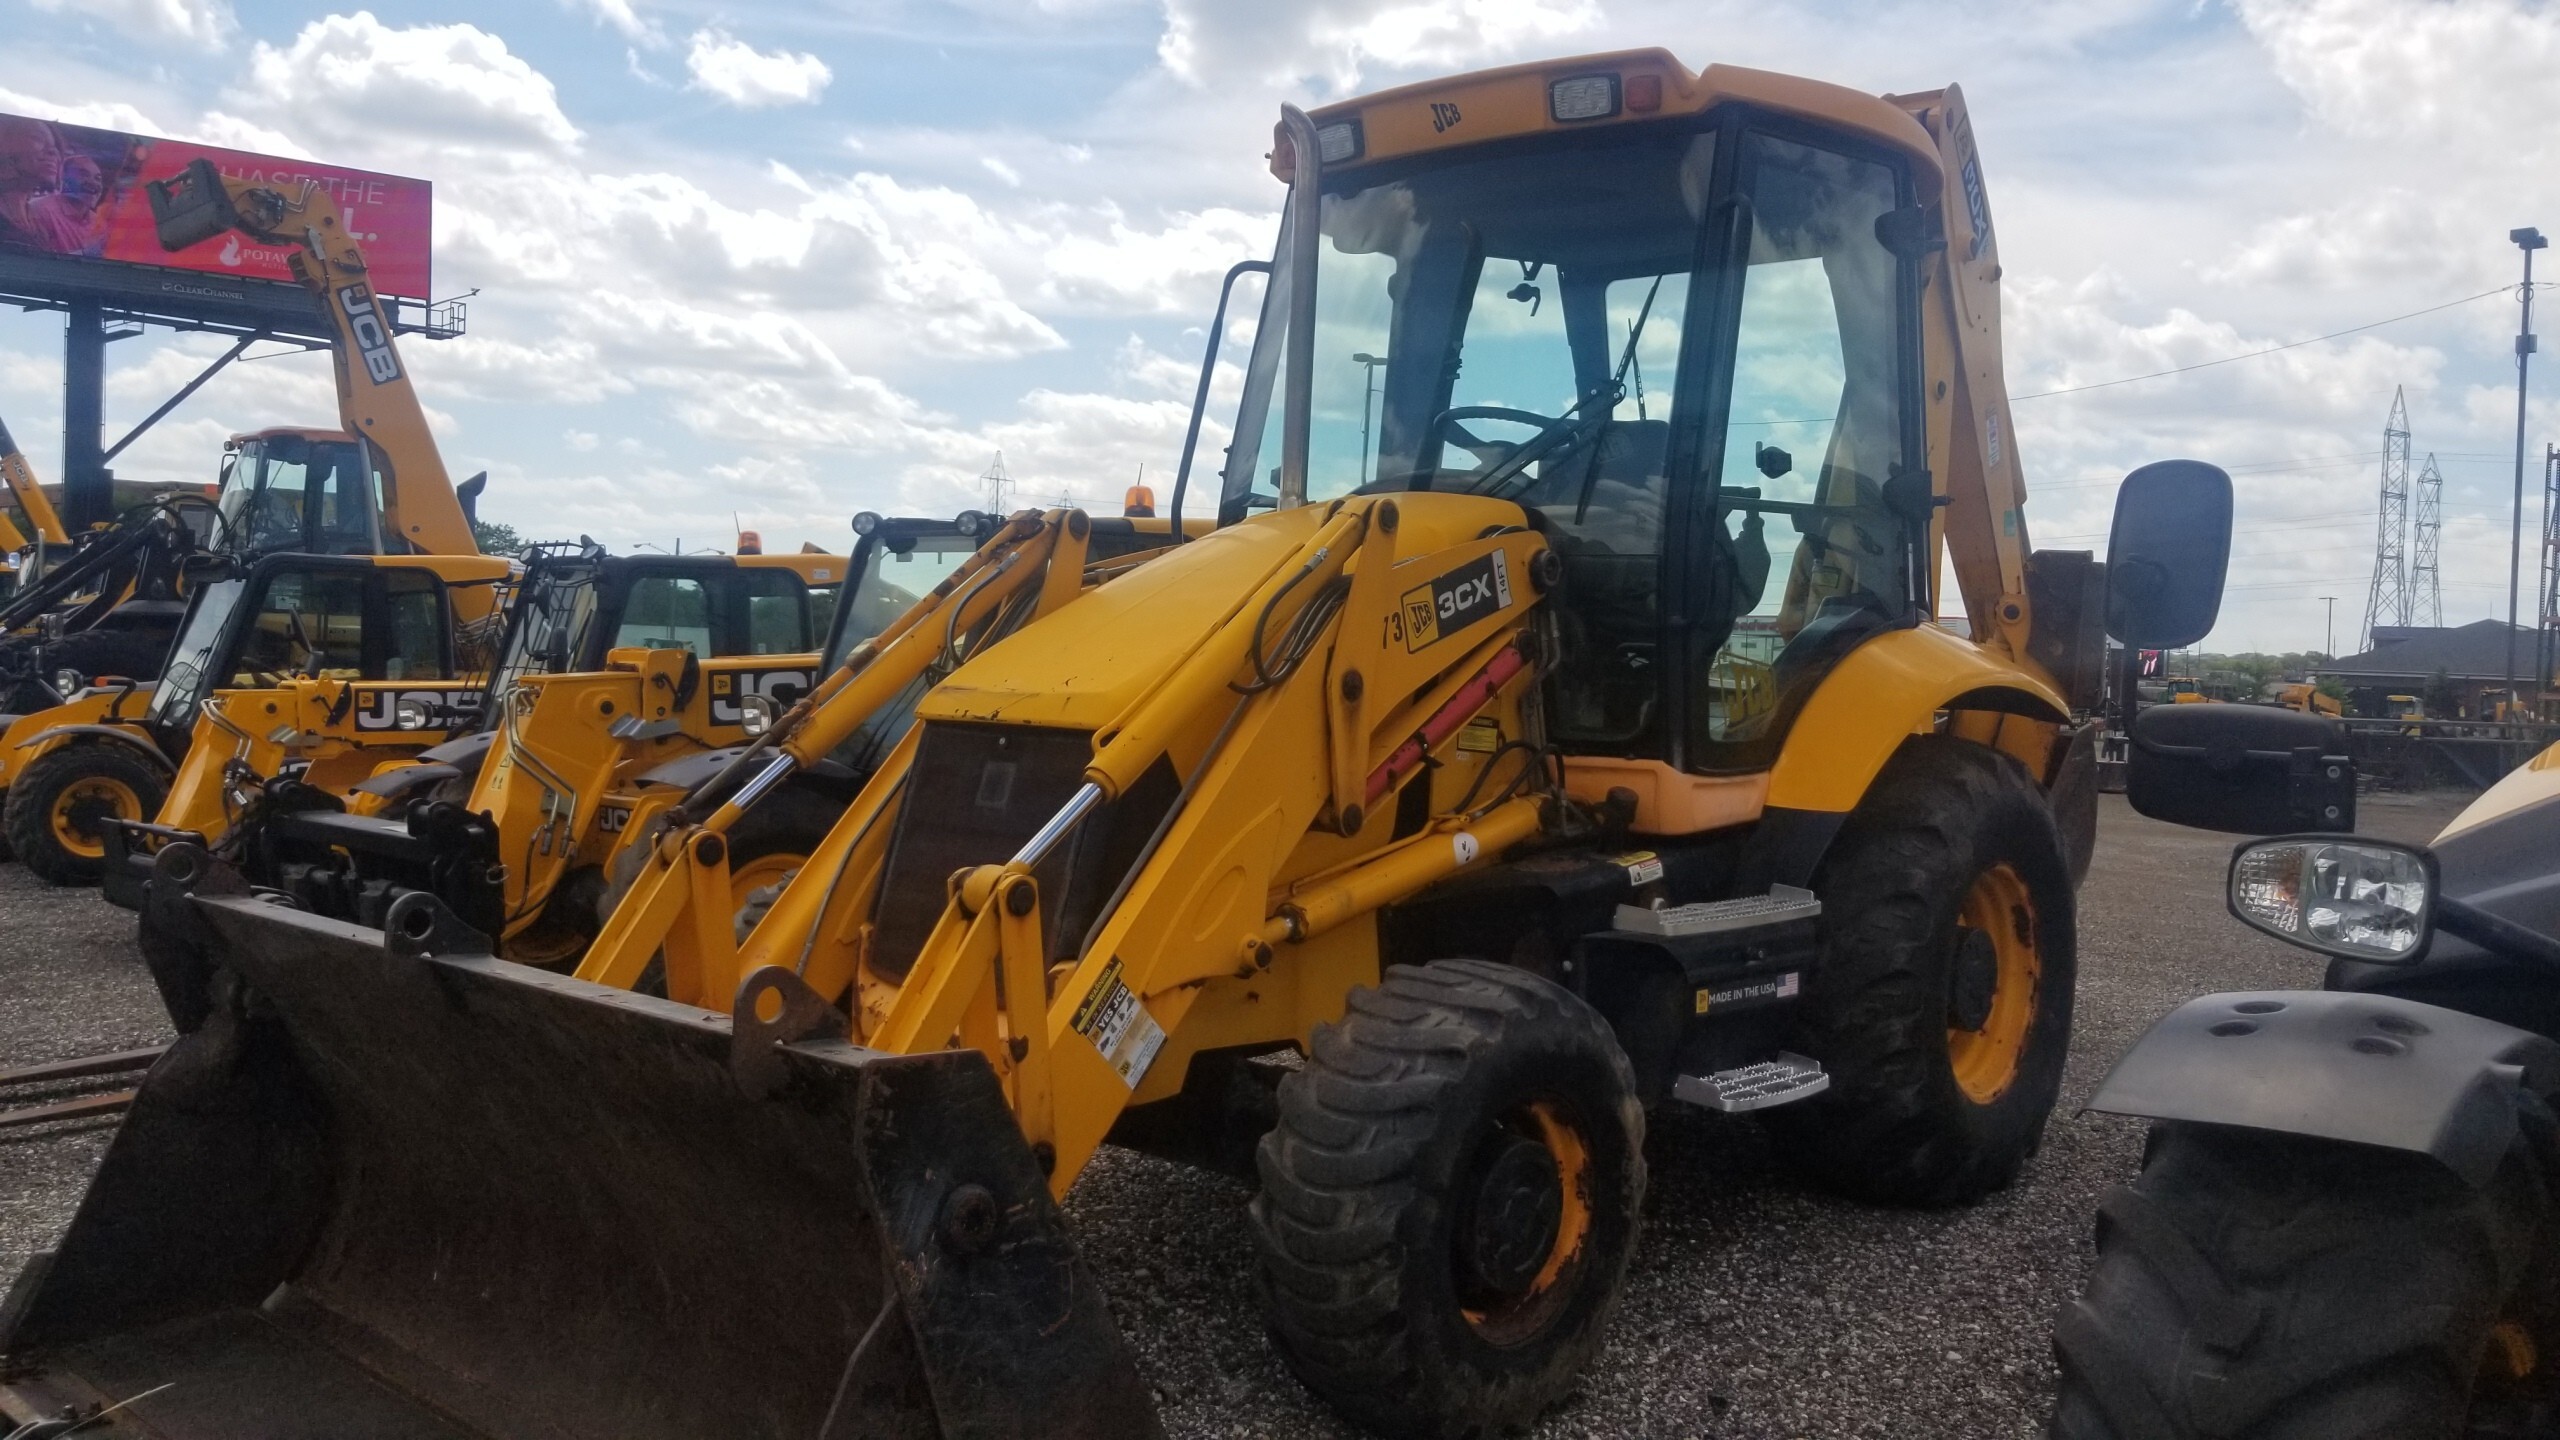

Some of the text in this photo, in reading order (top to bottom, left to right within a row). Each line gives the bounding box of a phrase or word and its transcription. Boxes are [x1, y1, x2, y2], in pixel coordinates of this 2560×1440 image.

[1430, 103, 1461, 133] JCB
[322, 176, 386, 205] THE
[341, 288, 398, 382] JCB
[1496, 562, 1507, 595] 14FT
[1438, 572, 1492, 619] 3CX
[1410, 604, 1432, 634] JCB
[713, 671, 818, 721] JC
[601, 807, 634, 832] JC
[1088, 968, 1112, 1001] WARNING
[1709, 982, 1776, 1005] MADE IN THE USA
[1098, 1008, 1115, 1029] YES
[1113, 986, 1129, 1009] JCB
